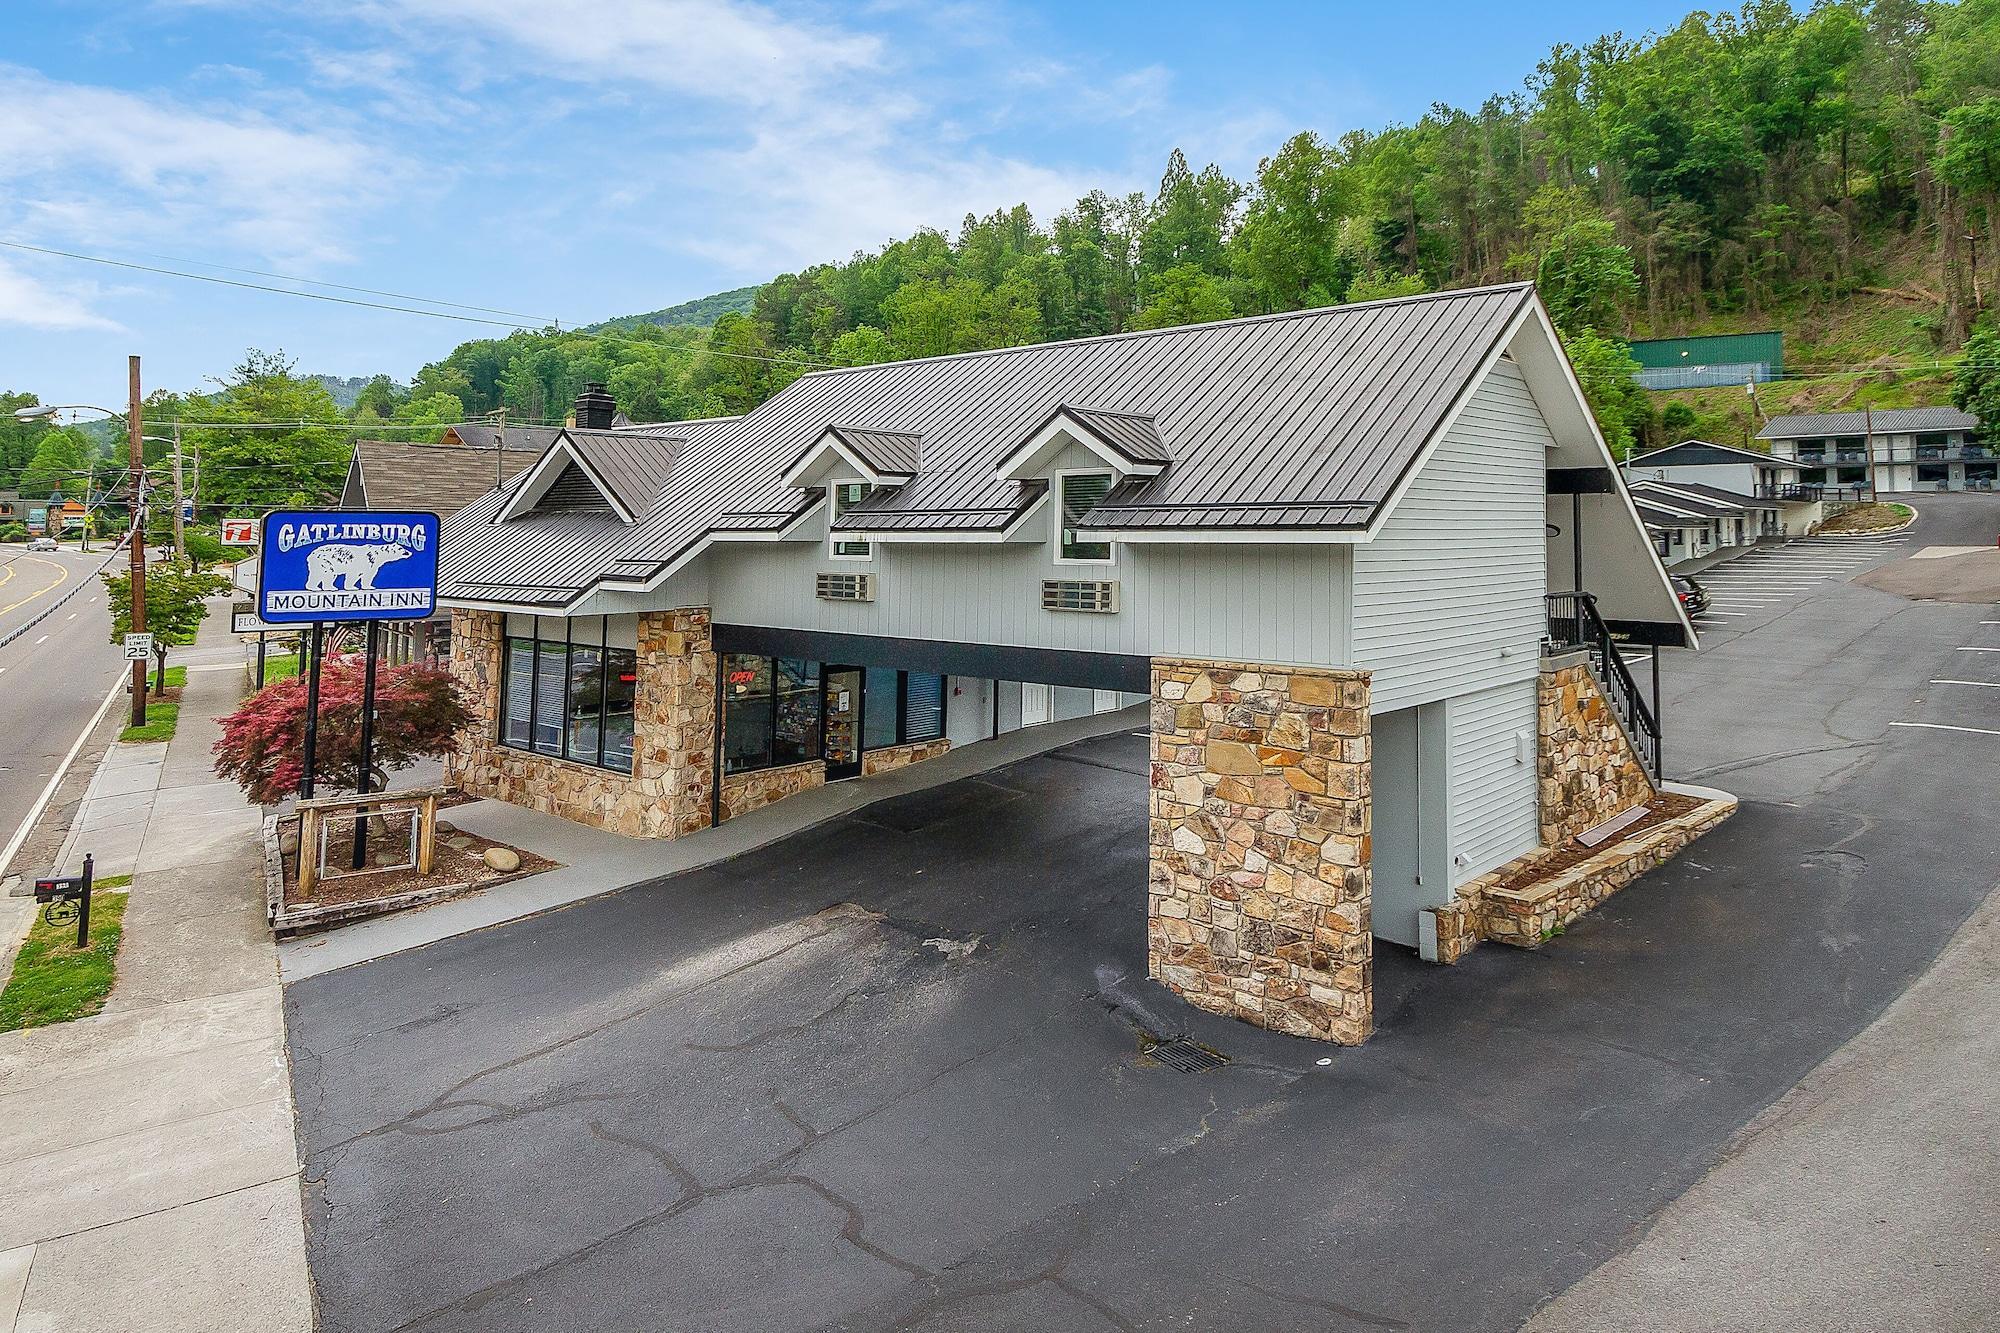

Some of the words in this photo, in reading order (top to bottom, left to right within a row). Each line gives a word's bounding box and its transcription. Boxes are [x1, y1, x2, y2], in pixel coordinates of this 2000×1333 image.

[278, 523, 427, 553] GATLINBURG
[273, 593, 383, 609] MOUNTAIN
[390, 592, 424, 606] INN
[127, 647, 148, 657] 25
[729, 671, 756, 684] OPEN
